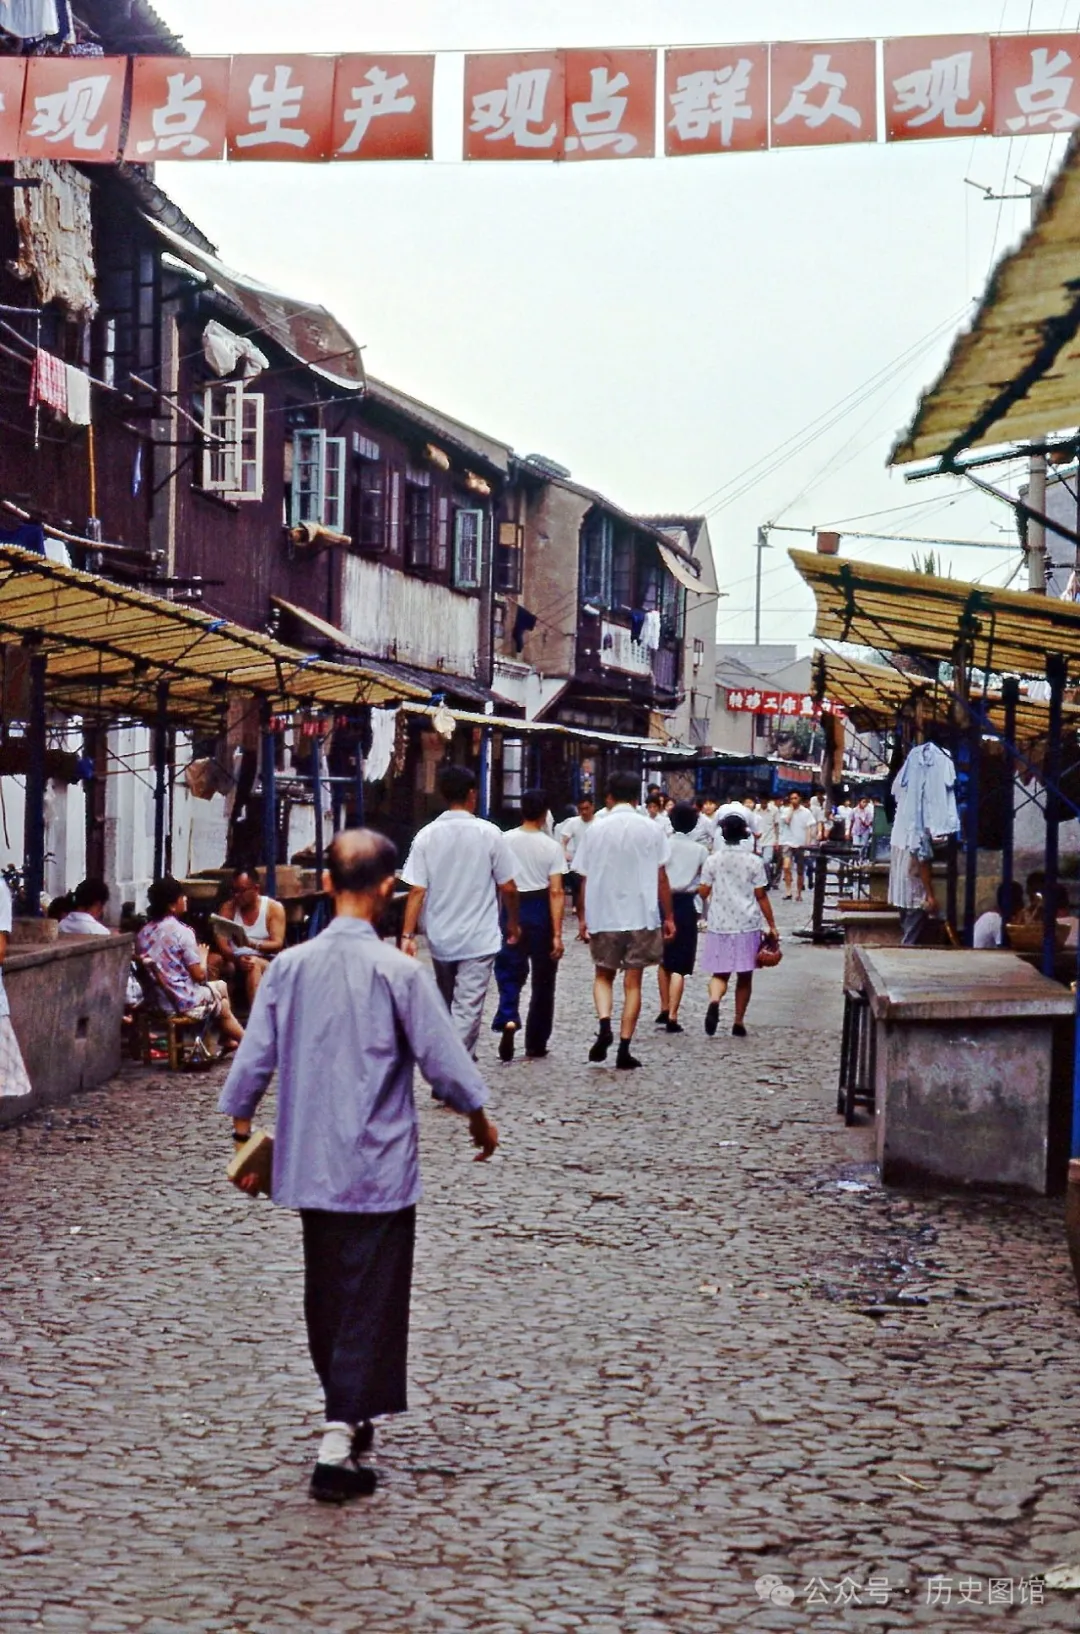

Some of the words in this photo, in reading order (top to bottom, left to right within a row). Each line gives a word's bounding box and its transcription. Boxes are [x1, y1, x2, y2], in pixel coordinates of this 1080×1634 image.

[0, 47, 1080, 156] 观点生产观点群众观点
